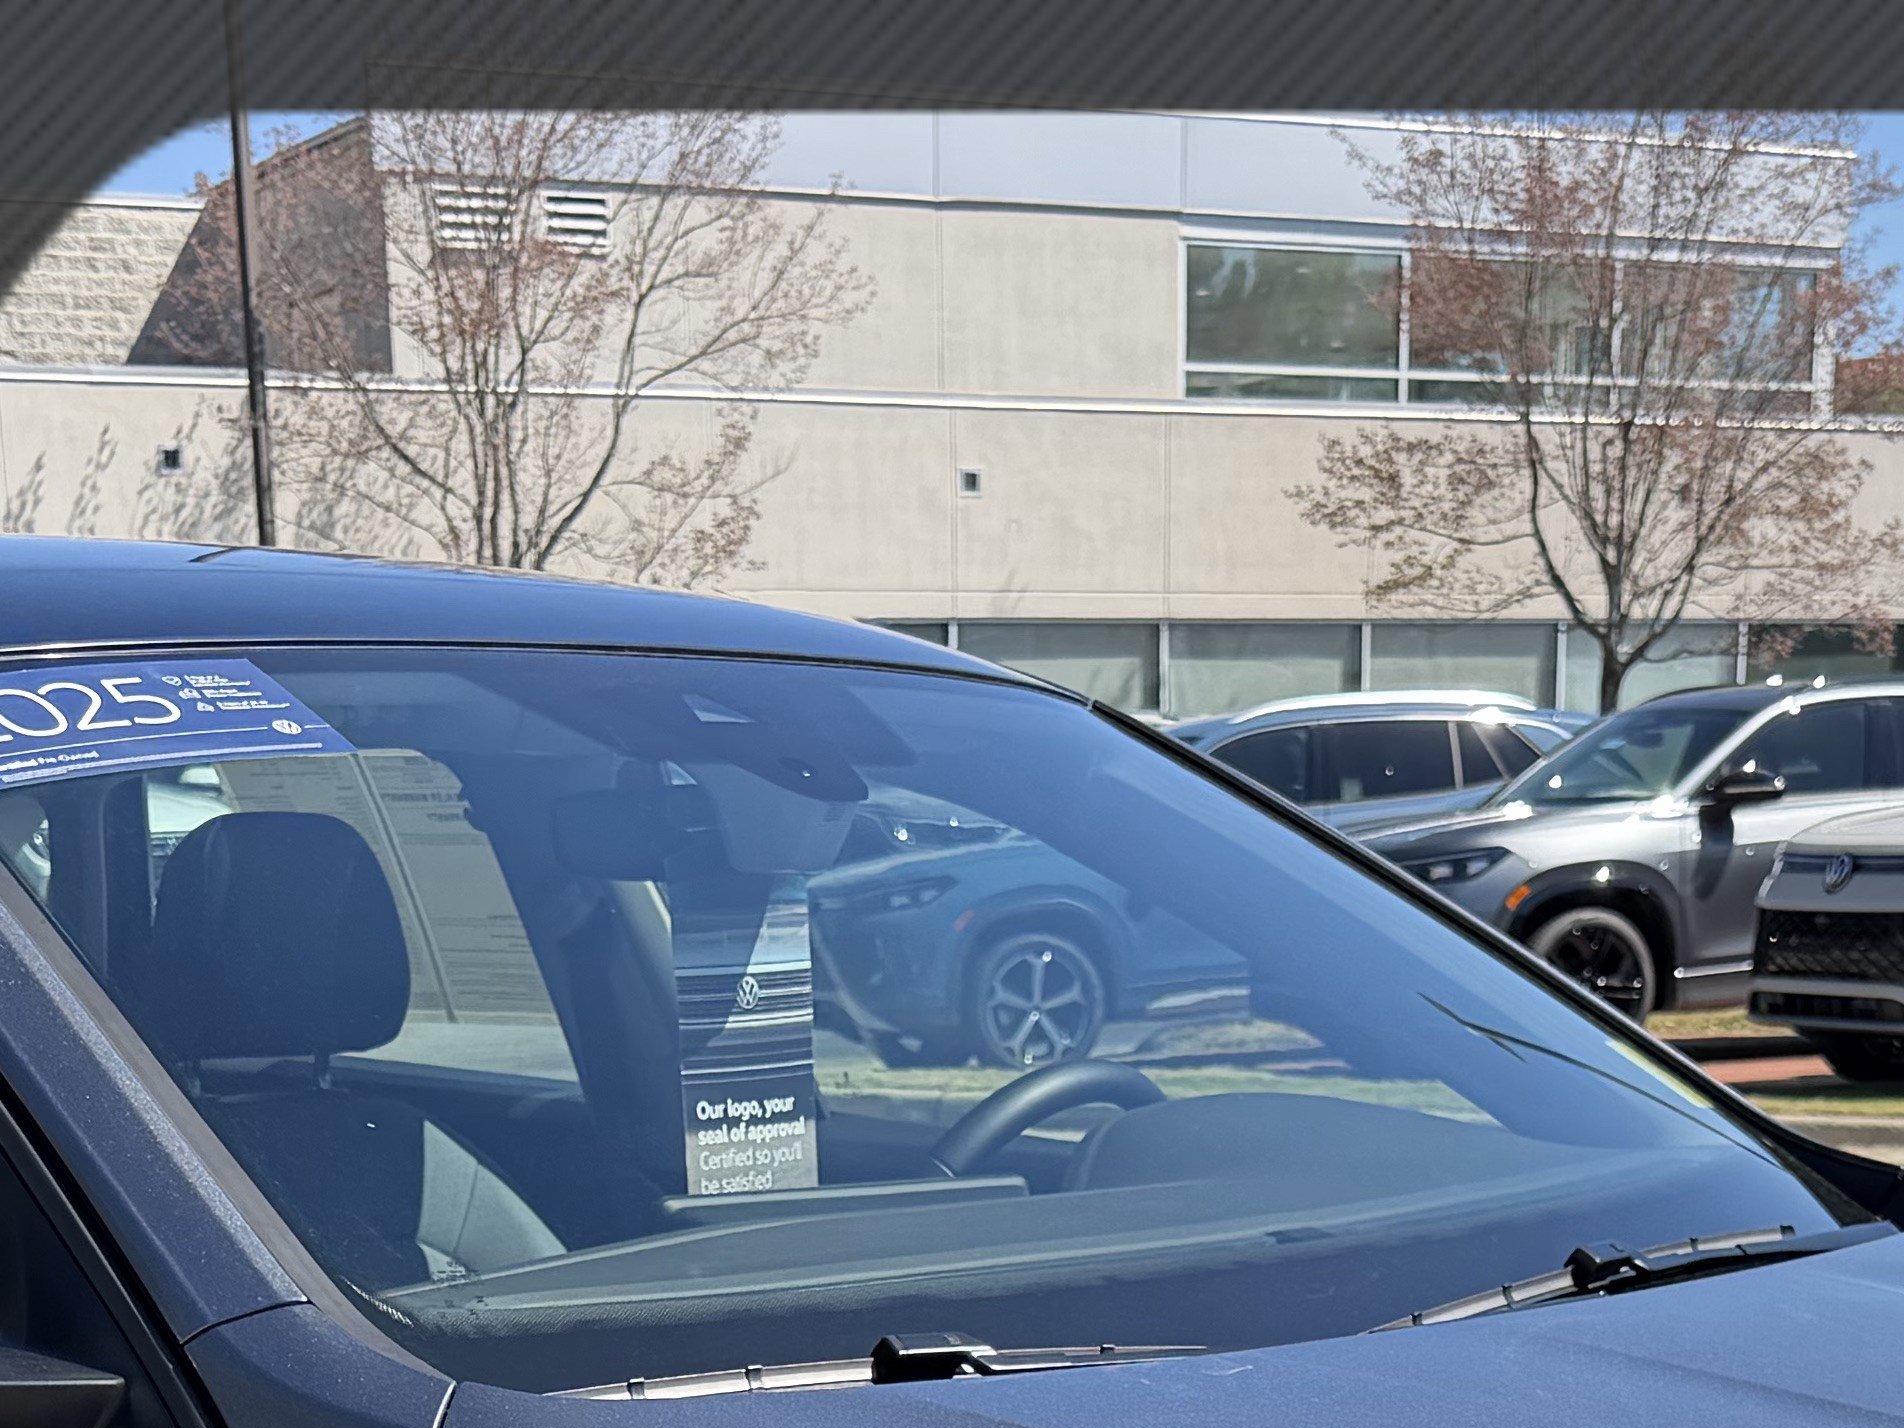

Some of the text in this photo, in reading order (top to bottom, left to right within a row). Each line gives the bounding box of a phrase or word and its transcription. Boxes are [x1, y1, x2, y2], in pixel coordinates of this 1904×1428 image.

[696, 1096, 795, 1121] Our logo, your
[698, 1115, 806, 1146] seal of approval
[699, 1146, 754, 1171] Certified
[755, 1148, 771, 1165] so
[700, 1169, 773, 1195] be satisfied
